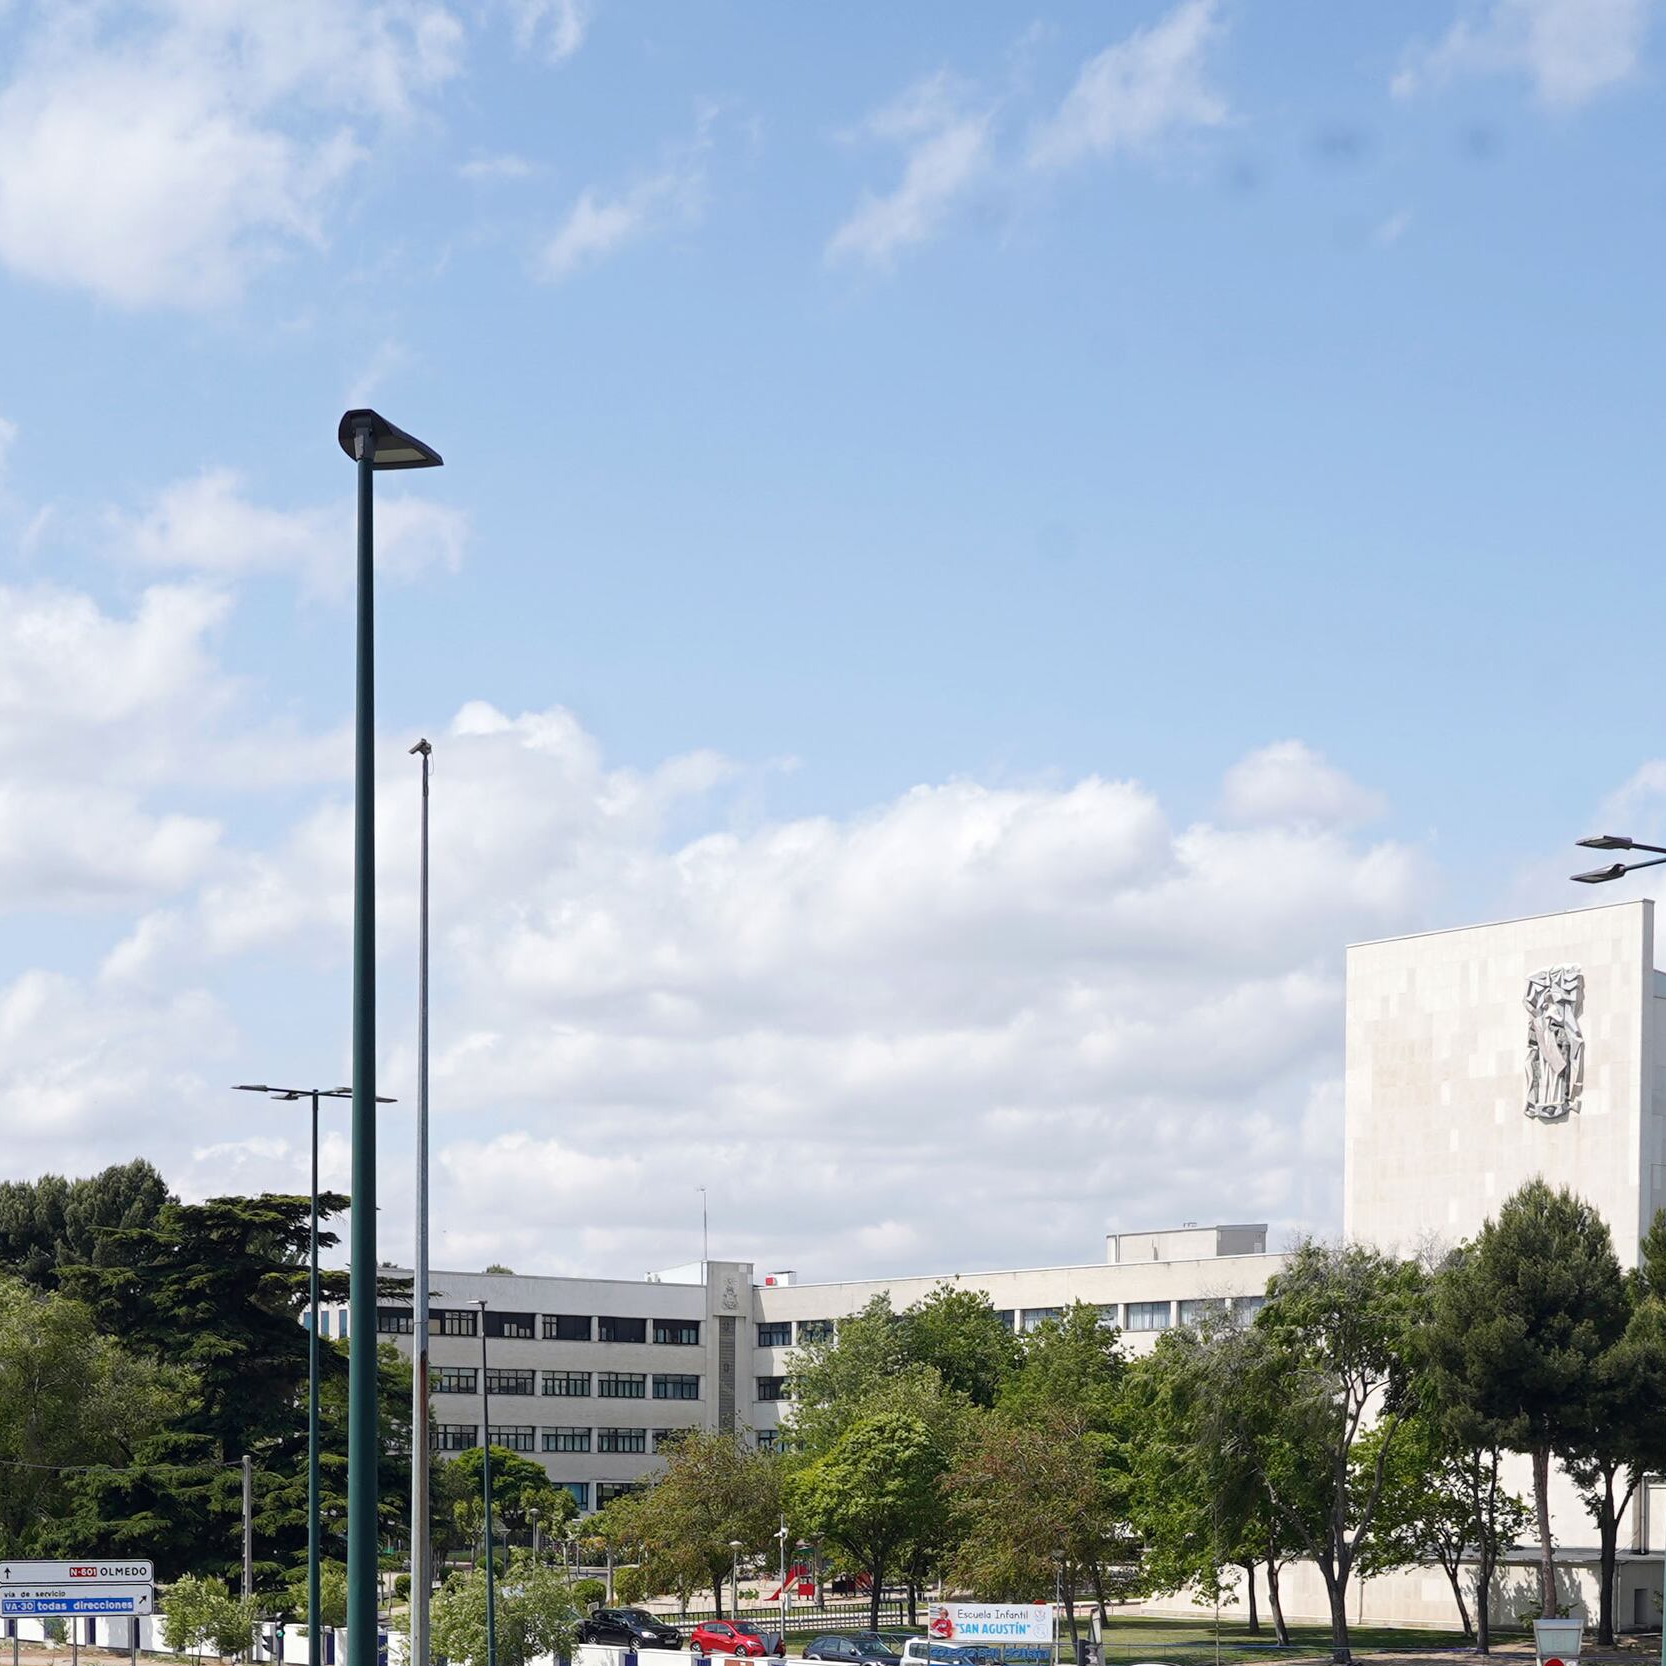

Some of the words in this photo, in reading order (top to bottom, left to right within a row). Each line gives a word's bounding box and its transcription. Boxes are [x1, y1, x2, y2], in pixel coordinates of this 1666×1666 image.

[70, 1567, 97, 1577] N-601
[100, 1566, 147, 1576] OLMEDO
[35, 1590, 66, 1598] servicio
[4, 1601, 33, 1611] VA-30
[37, 1600, 67, 1611] todas
[73, 1598, 133, 1611] direcciones
[957, 1608, 992, 1619] Escuela
[995, 1609, 1029, 1620] Infantil
[955, 1622, 979, 1634] "SAN
[981, 1621, 1031, 1635] AGUSTÍN"
